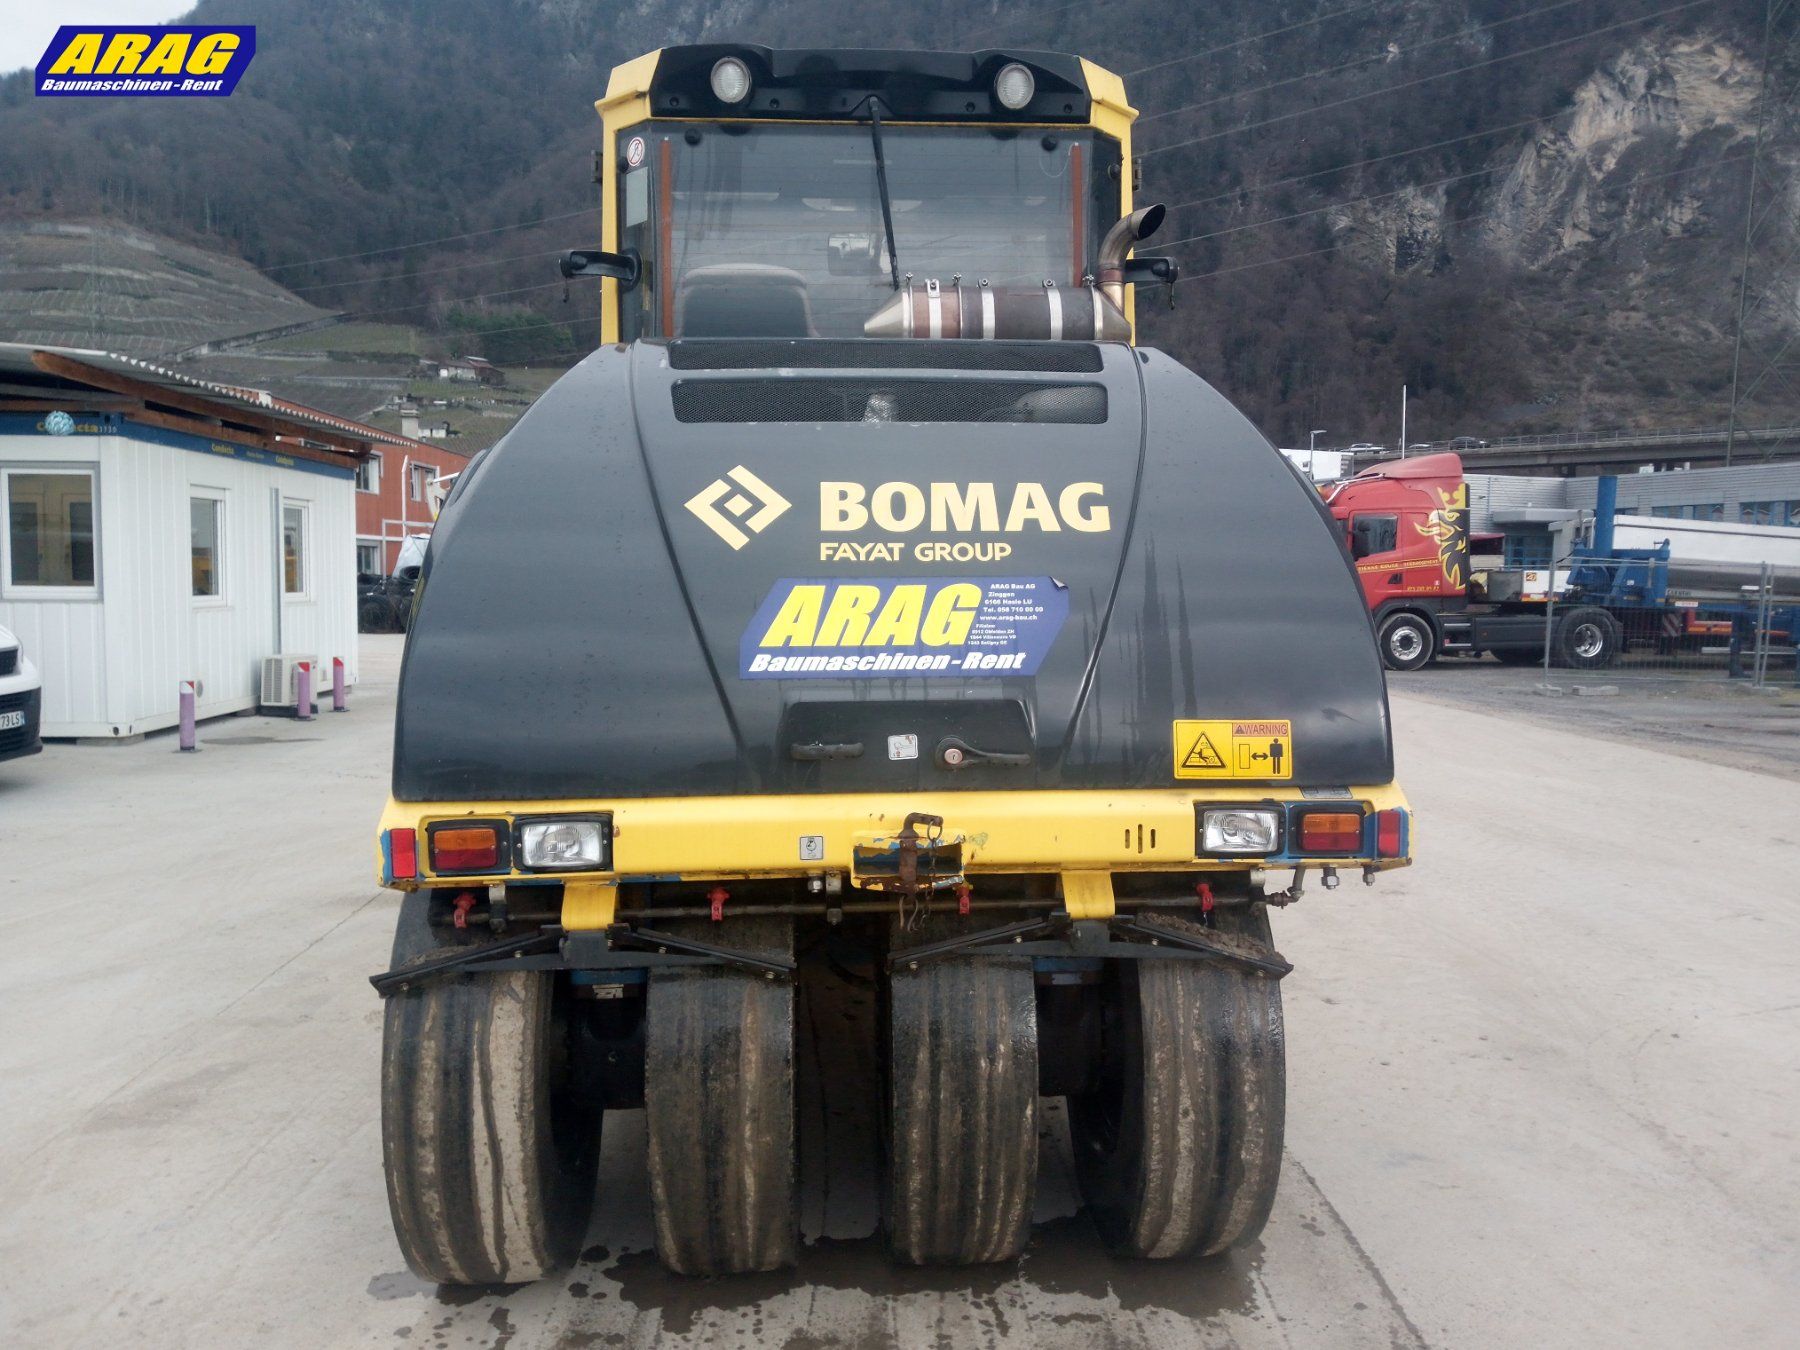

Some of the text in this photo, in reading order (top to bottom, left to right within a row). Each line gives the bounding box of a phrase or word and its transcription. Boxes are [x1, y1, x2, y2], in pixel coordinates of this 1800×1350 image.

[820, 481, 1111, 533] BOMAG
[820, 542, 1012, 562] FAYAT GROUP
[758, 583, 982, 648] ARAG
[979, 614, 1038, 622] www.arag-bau.ch
[1245, 724, 1288, 735] WARNING
